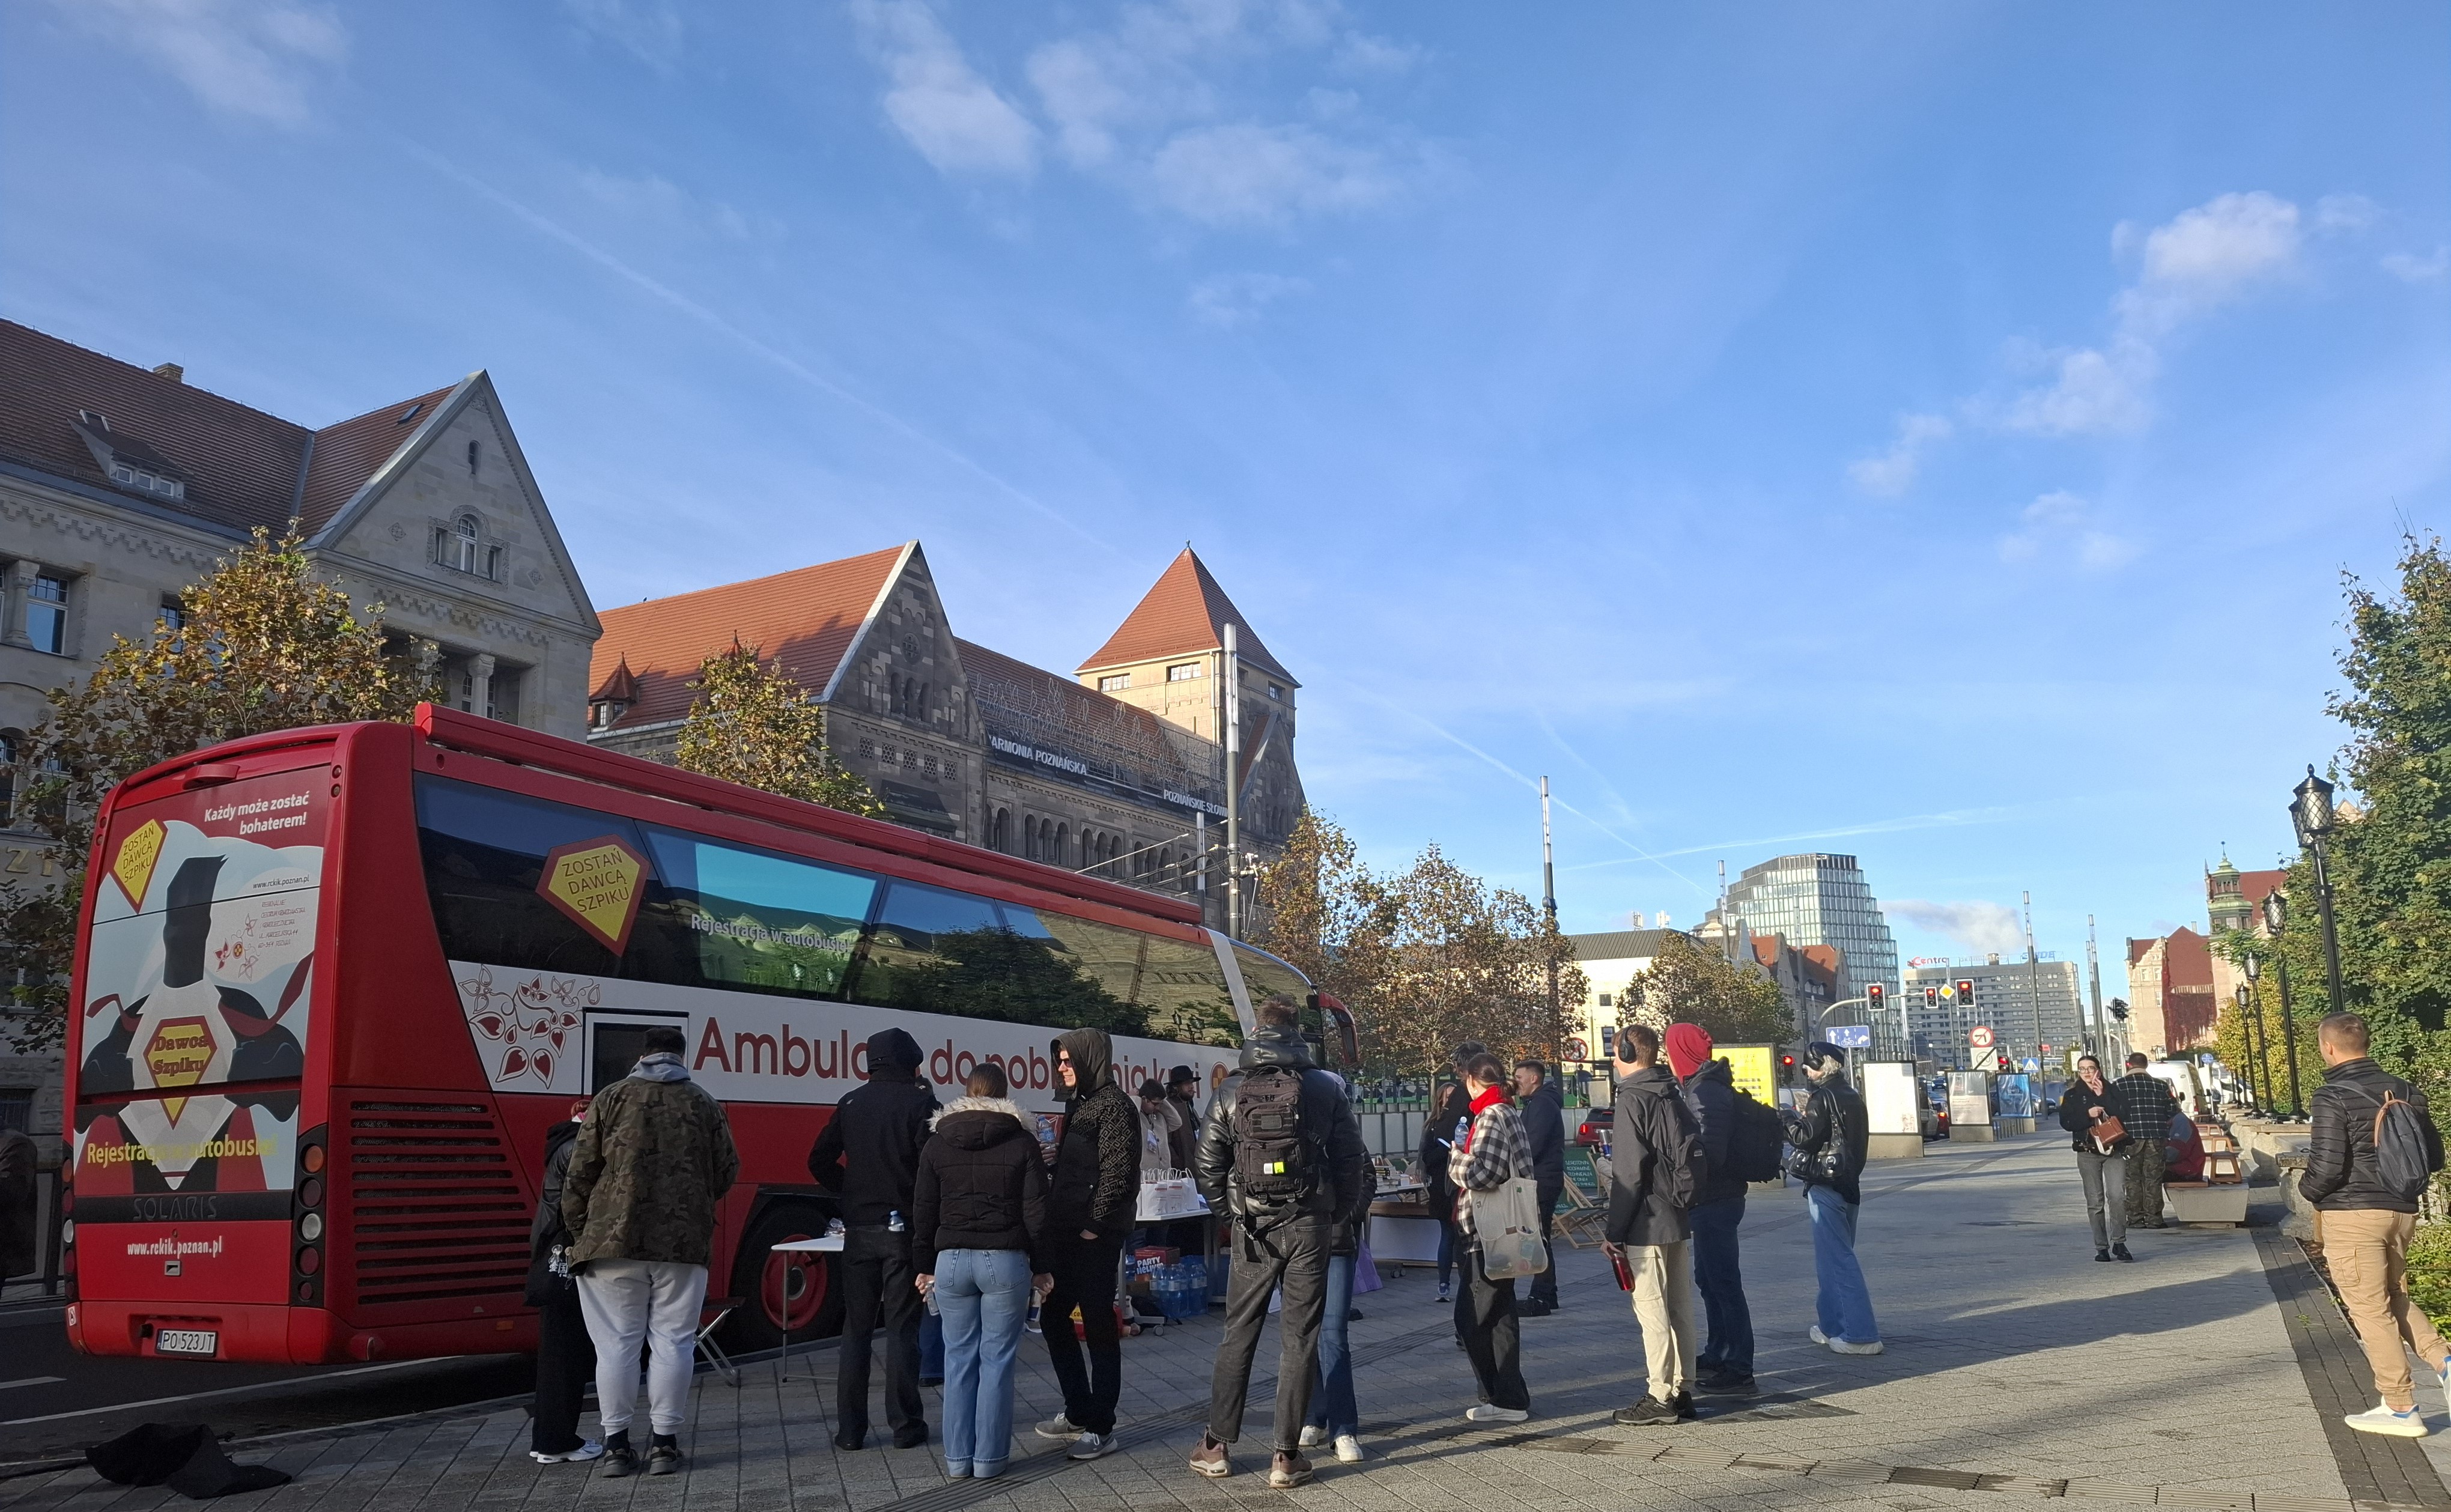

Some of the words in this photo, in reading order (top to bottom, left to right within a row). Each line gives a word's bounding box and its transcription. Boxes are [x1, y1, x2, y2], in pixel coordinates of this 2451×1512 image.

[989, 735, 1033, 761] ARMONIA
[1036, 749, 1087, 776] POZNAŃSKA
[204, 803, 236, 822] Każdy
[237, 798, 269, 816] może
[270, 791, 310, 810] zostać
[1164, 789, 1206, 812] POZNAŃSKIE
[239, 812, 307, 835] bohaterem!
[123, 823, 154, 856] ZOSTAŃ
[123, 841, 153, 869] DAWCĄ
[561, 848, 623, 877] ZOSTAŃ
[124, 855, 152, 883] SZPIKU
[253, 874, 310, 889] www.rckik.poznan.pl
[568, 869, 627, 895] DAWCĄ
[577, 887, 629, 912] SZPIKU
[691, 914, 768, 942] Rejestracja
[771, 929, 782, 943] w
[785, 932, 850, 953] autobusie!
[154, 1035, 208, 1052] Dawca
[693, 1016, 871, 1081] Ambula
[153, 1057, 205, 1077] Szpiku
[133, 1195, 217, 1221] SOLARIS
[127, 1235, 222, 1259] www.rckik.poznan.pl
[1137, 1256, 1161, 1268] PARTY
[162, 1332, 178, 1349] PO
[180, 1333, 214, 1352] 523JT
